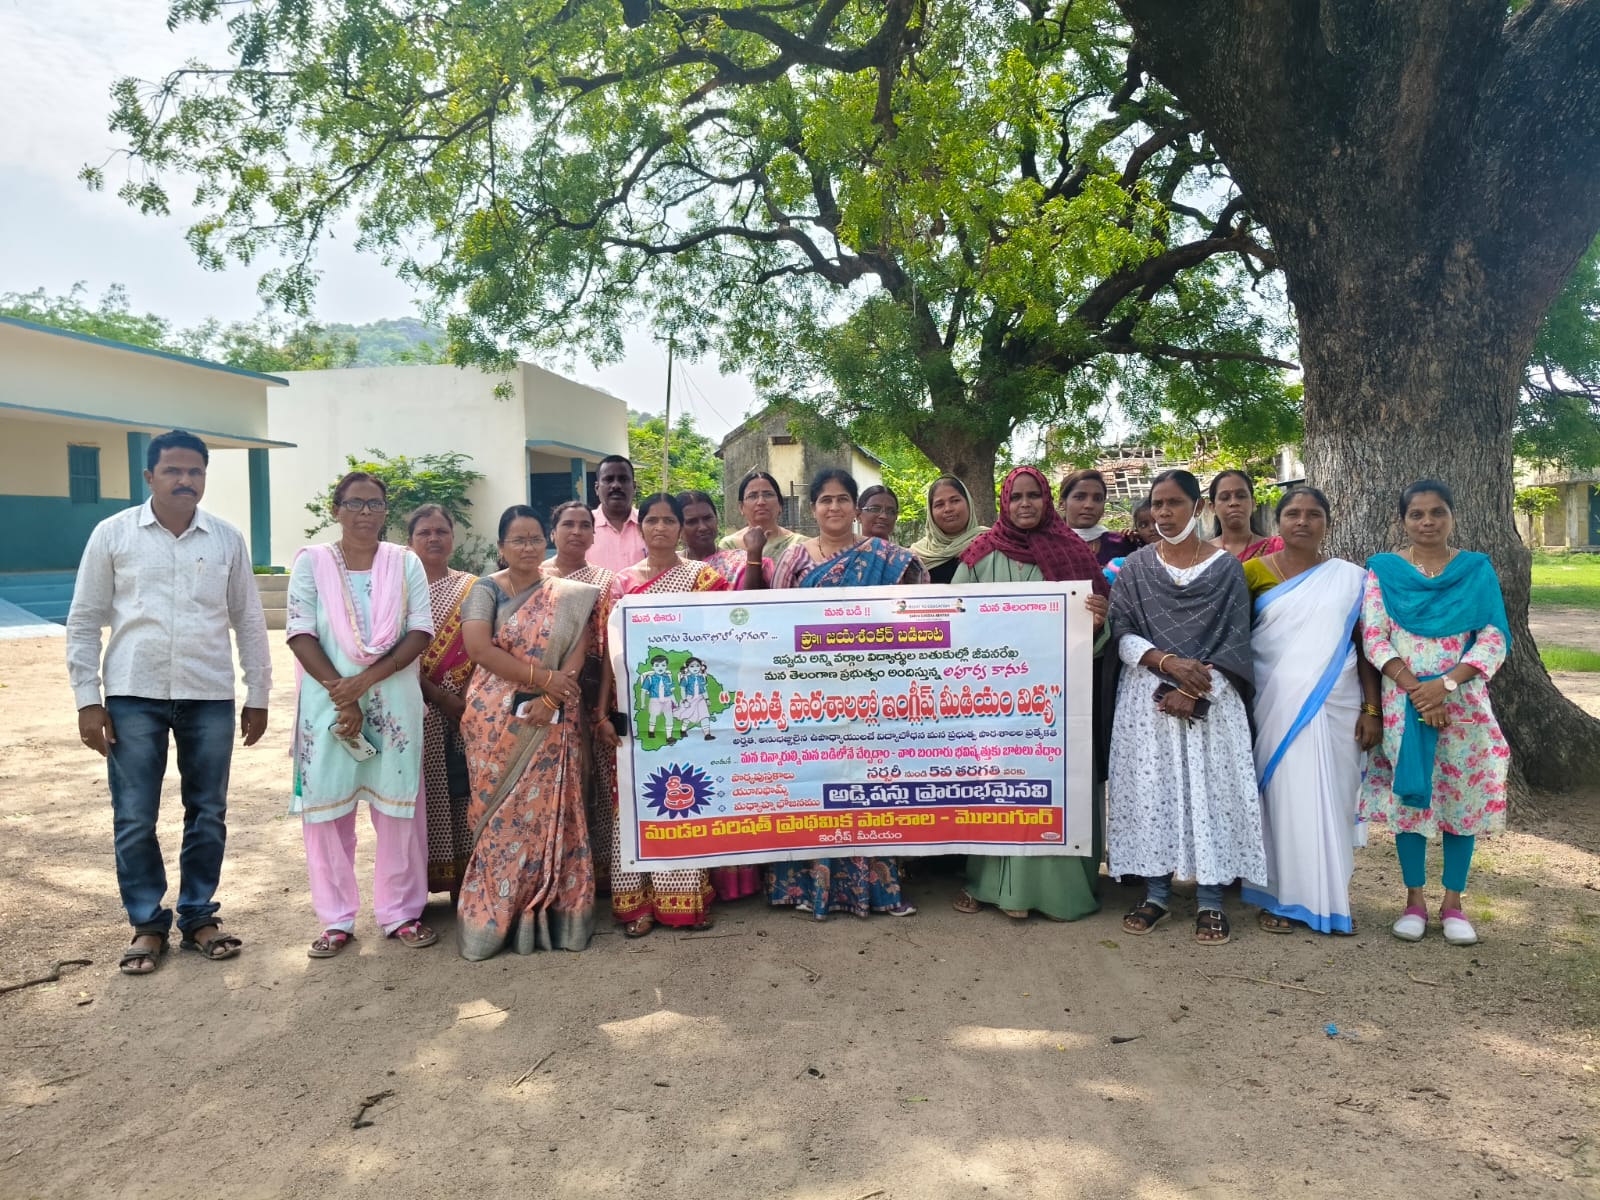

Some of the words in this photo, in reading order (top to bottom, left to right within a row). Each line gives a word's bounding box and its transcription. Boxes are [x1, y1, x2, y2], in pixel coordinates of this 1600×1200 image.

[824, 608, 844, 617] మన
[846, 605, 862, 617] బడి
[980, 603, 1000, 613] మన
[1002, 602, 1047, 612] తెలంగాణ
[632, 614, 650, 623] మన
[653, 613, 676, 622] ఊరు
[826, 627, 895, 644] జయశంకర్
[898, 626, 944, 643] బడిబాట
[809, 653, 833, 667] అన్ని
[833, 652, 865, 667] వర్గాల
[919, 647, 969, 662] బతుకుల్లో
[972, 645, 1019, 660] జీవనరేఖ
[764, 671, 787, 681] మన
[789, 670, 838, 680] తెలంగాణ
[840, 669, 886, 682] ప్రభుత్వం
[888, 666, 943, 681] అందిస్తున్న
[943, 663, 987, 681] అపూర్వ
[992, 661, 1029, 678] కానుక
[734, 690, 788, 733] ప్రభుత్వ
[789, 688, 879, 726] పాఠశాలల్లో
[882, 680, 937, 723] ఇంగ్లీష్
[939, 684, 1014, 718] మీడియం
[927, 730, 946, 739] మన
[948, 730, 977, 741] ప్రభుత్వ
[741, 751, 758, 764] మన
[802, 749, 819, 762] మన
[821, 746, 854, 761] బడిలోనే
[898, 747, 916, 759] వారి
[918, 746, 953, 758] బంగారు
[1003, 744, 1033, 757] బాటలు
[1035, 742, 1062, 762] వేద్దాం
[867, 765, 902, 783] నర్సరీ
[929, 766, 953, 778] 5వ
[955, 764, 1001, 779] తరగతి
[916, 782, 1048, 804] ప్రారంభమైనవి
[645, 823, 708, 840] మండల
[711, 815, 772, 836] పరిషత్
[776, 812, 853, 833] ప్రాథమిక
[857, 812, 935, 828] పాఠశాల
[954, 808, 1054, 826] మొలంగూర్
[818, 829, 852, 844] ఇంగ్లీష్
[856, 830, 903, 841] మీడియం
